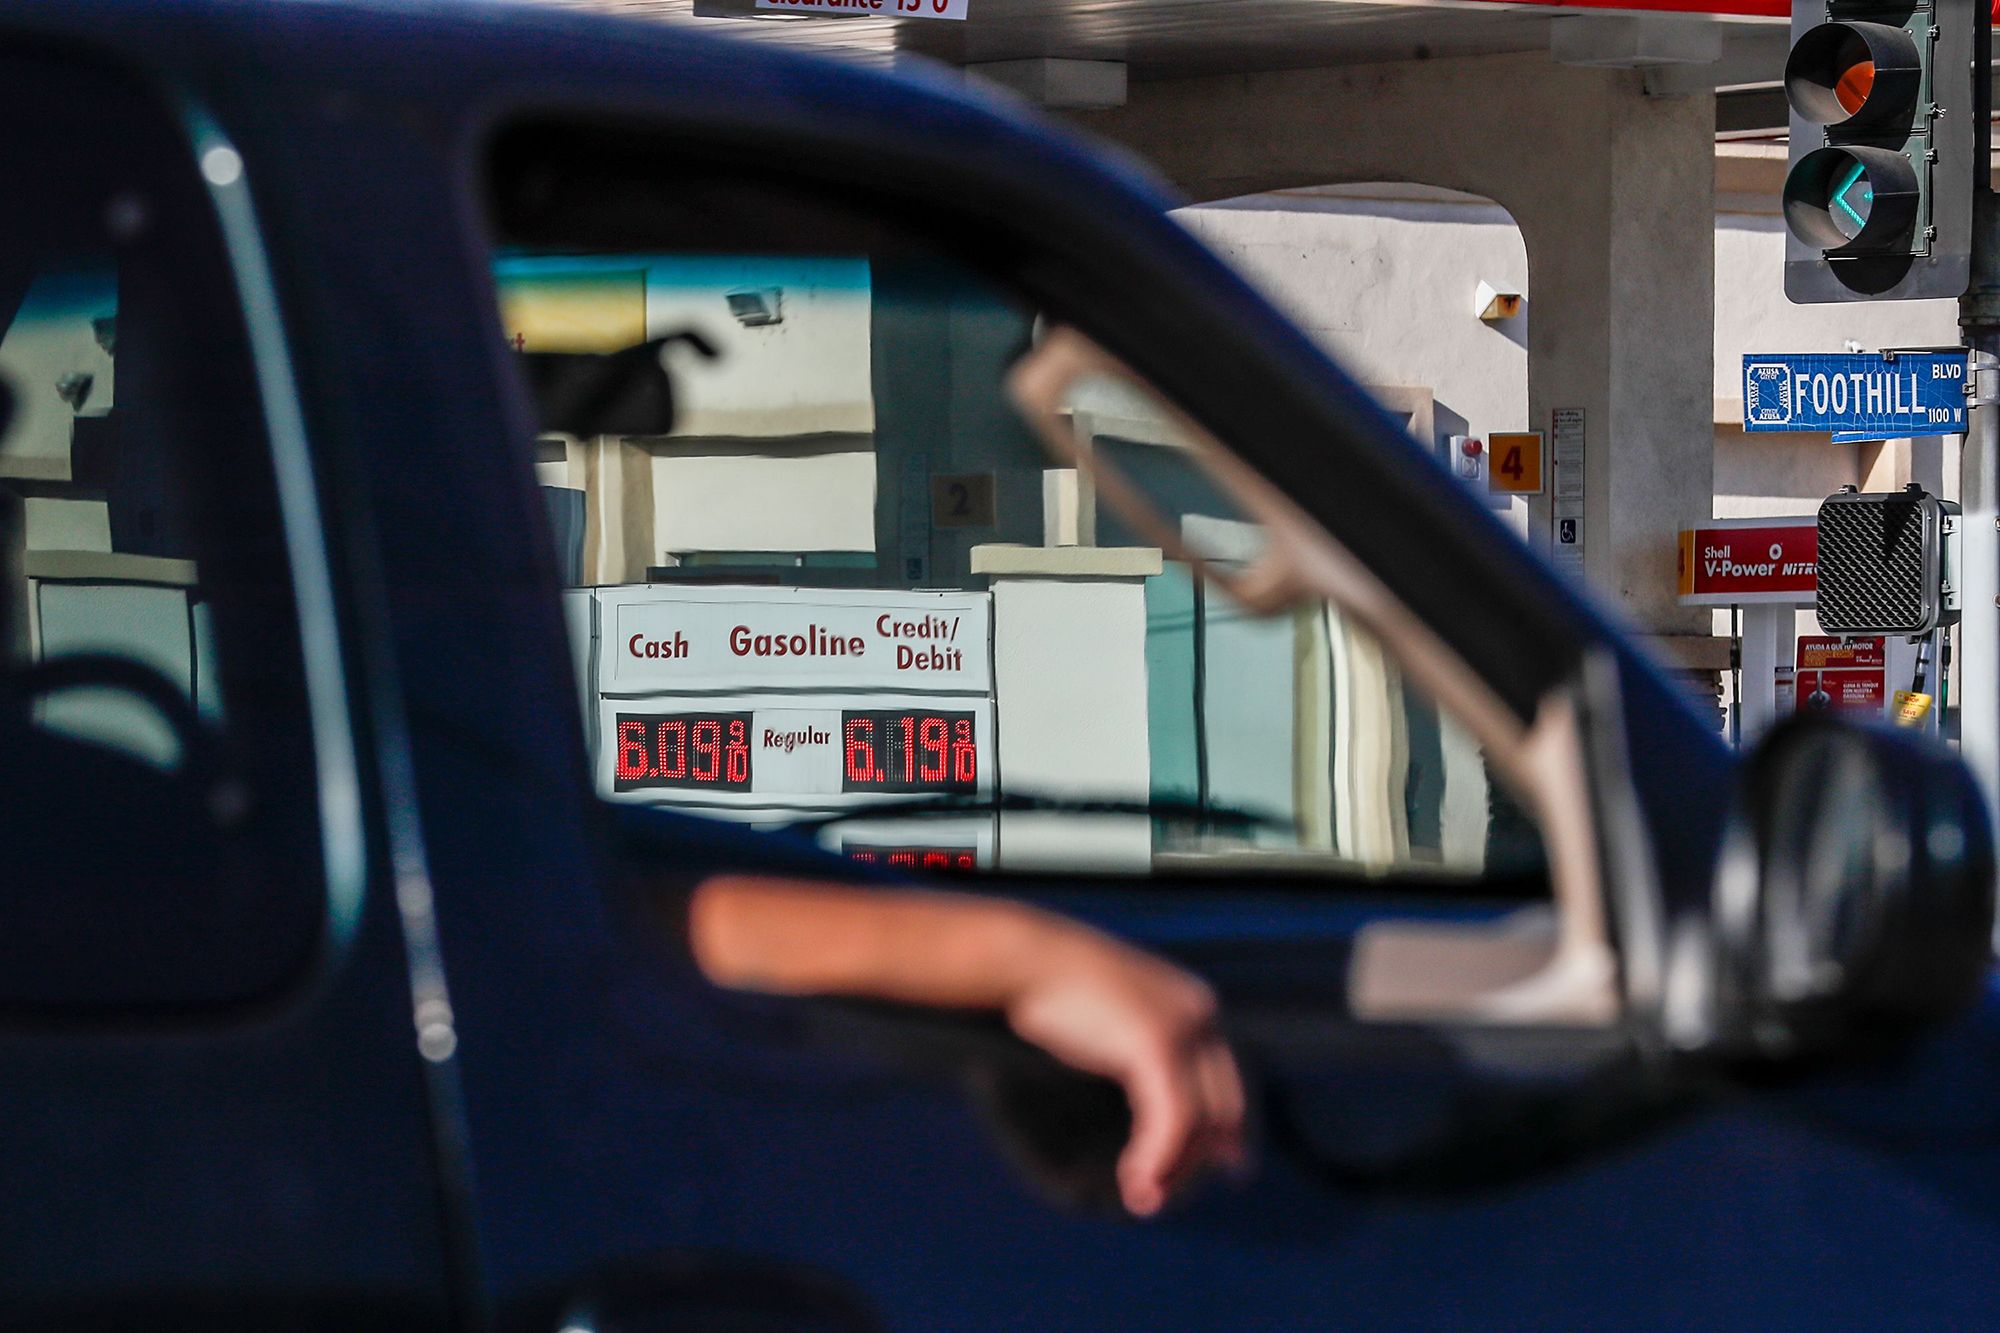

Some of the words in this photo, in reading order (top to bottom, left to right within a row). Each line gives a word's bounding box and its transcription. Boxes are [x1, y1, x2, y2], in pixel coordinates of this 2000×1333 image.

[1932, 364, 1962, 379] BLVD
[1795, 373, 1926, 415] FOOTHILL
[1928, 408, 1950, 423] 1100
[1953, 408, 1962, 423] W
[1501, 446, 1524, 480] 4
[948, 483, 970, 517] 2
[1704, 545, 1731, 559] Shell
[1704, 560, 1776, 578] V-Power
[730, 624, 865, 657] Gasoline
[876, 614, 960, 642] Credit/
[629, 631, 689, 659] Cash
[897, 644, 962, 671] Debit
[1852, 642, 1873, 650] MOTOR
[616, 720, 721, 781] 6.09
[763, 725, 831, 753] Regular
[846, 717, 949, 782] 6.19
